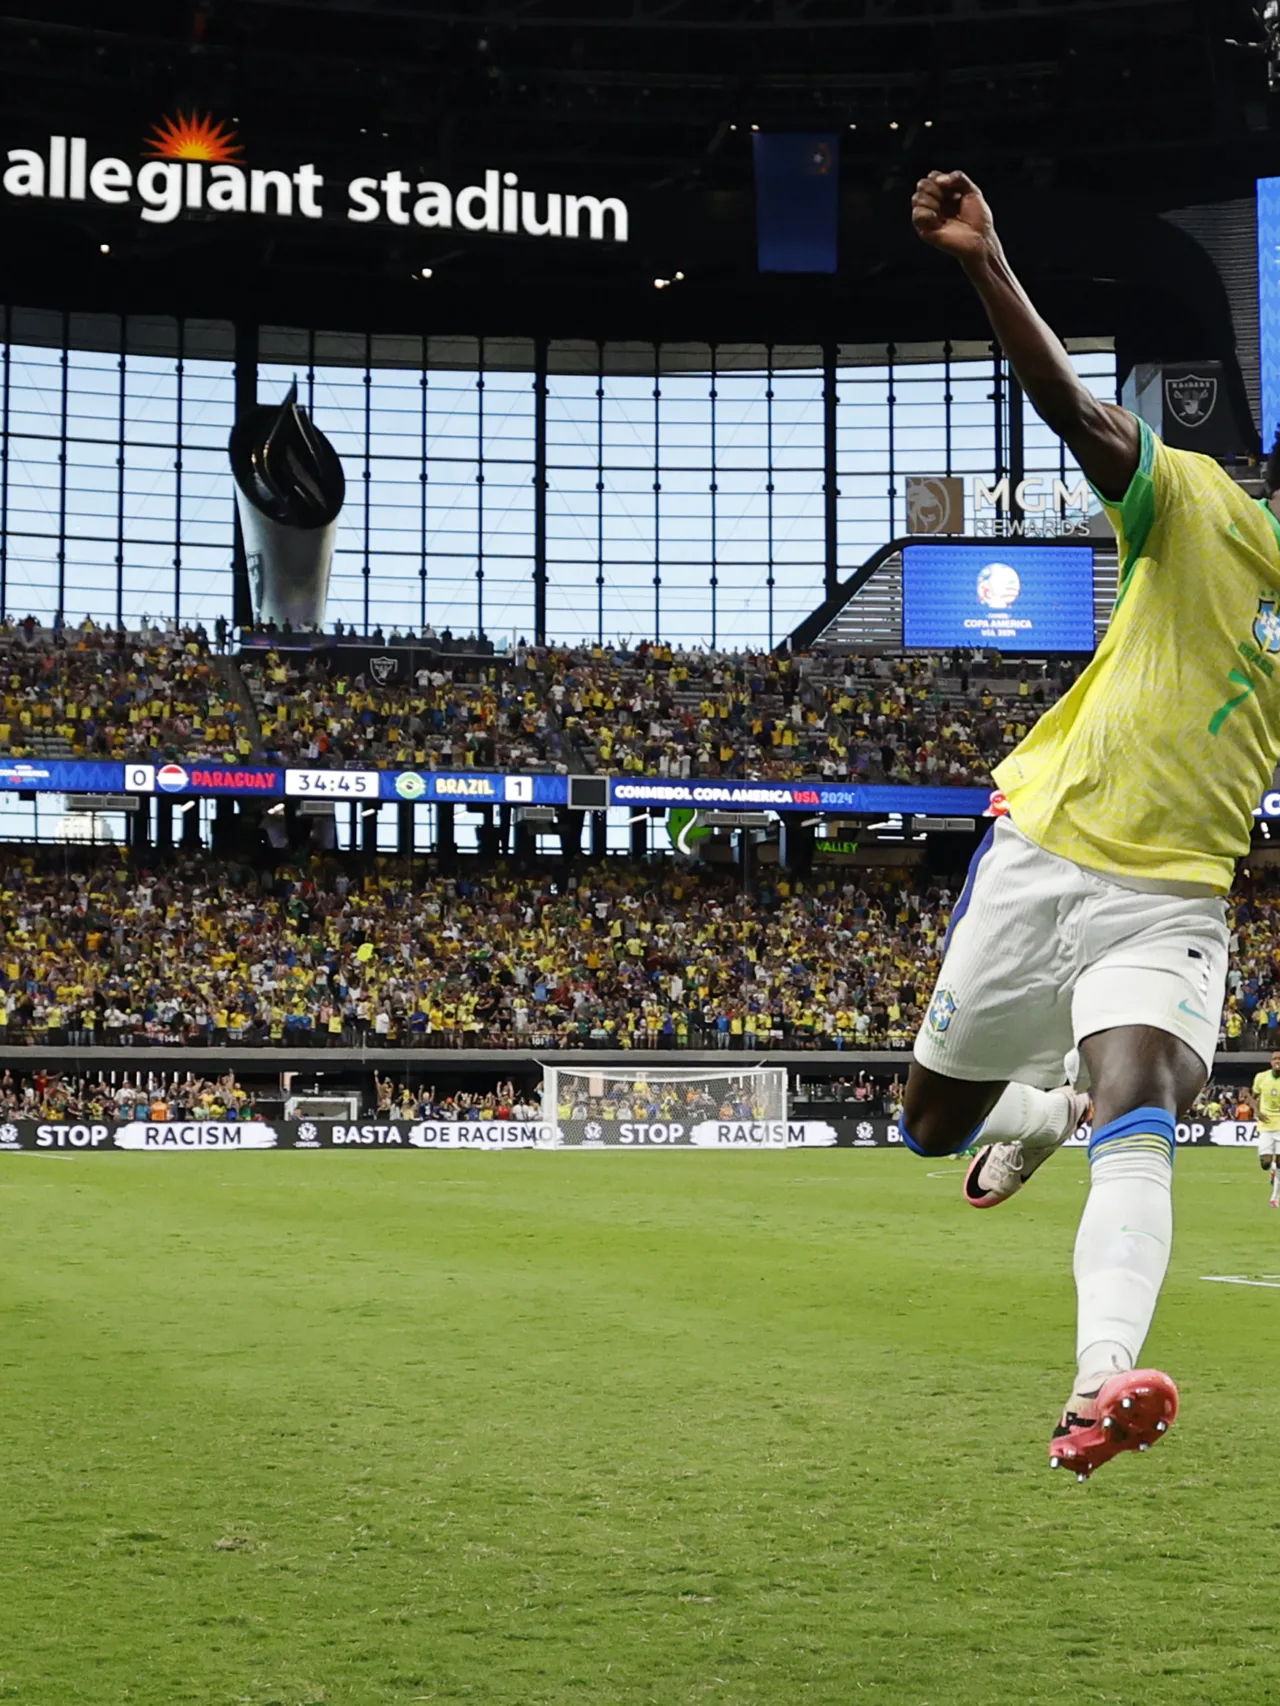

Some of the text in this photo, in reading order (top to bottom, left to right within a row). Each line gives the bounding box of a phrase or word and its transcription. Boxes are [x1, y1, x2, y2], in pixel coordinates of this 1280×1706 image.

[3, 136, 628, 241] allegiant stadium
[973, 477, 1090, 513] MGM
[973, 518, 1091, 537] REWARDS
[963, 618, 989, 629] COPA
[1207, 667, 1256, 737] 7
[191, 770, 276, 790] PARAGUAY
[298, 774, 367, 793] 34:45
[435, 777, 495, 796] BRAZIL
[614, 785, 854, 804] CONMEBOL COPA AMERICA USA 2024
[815, 840, 860, 854] VALLEY
[36, 1125, 242, 1147] STOP RACISM
[331, 1126, 553, 1144] BASTA DE RACISMO
[619, 1124, 806, 1143] STOP RACISM
